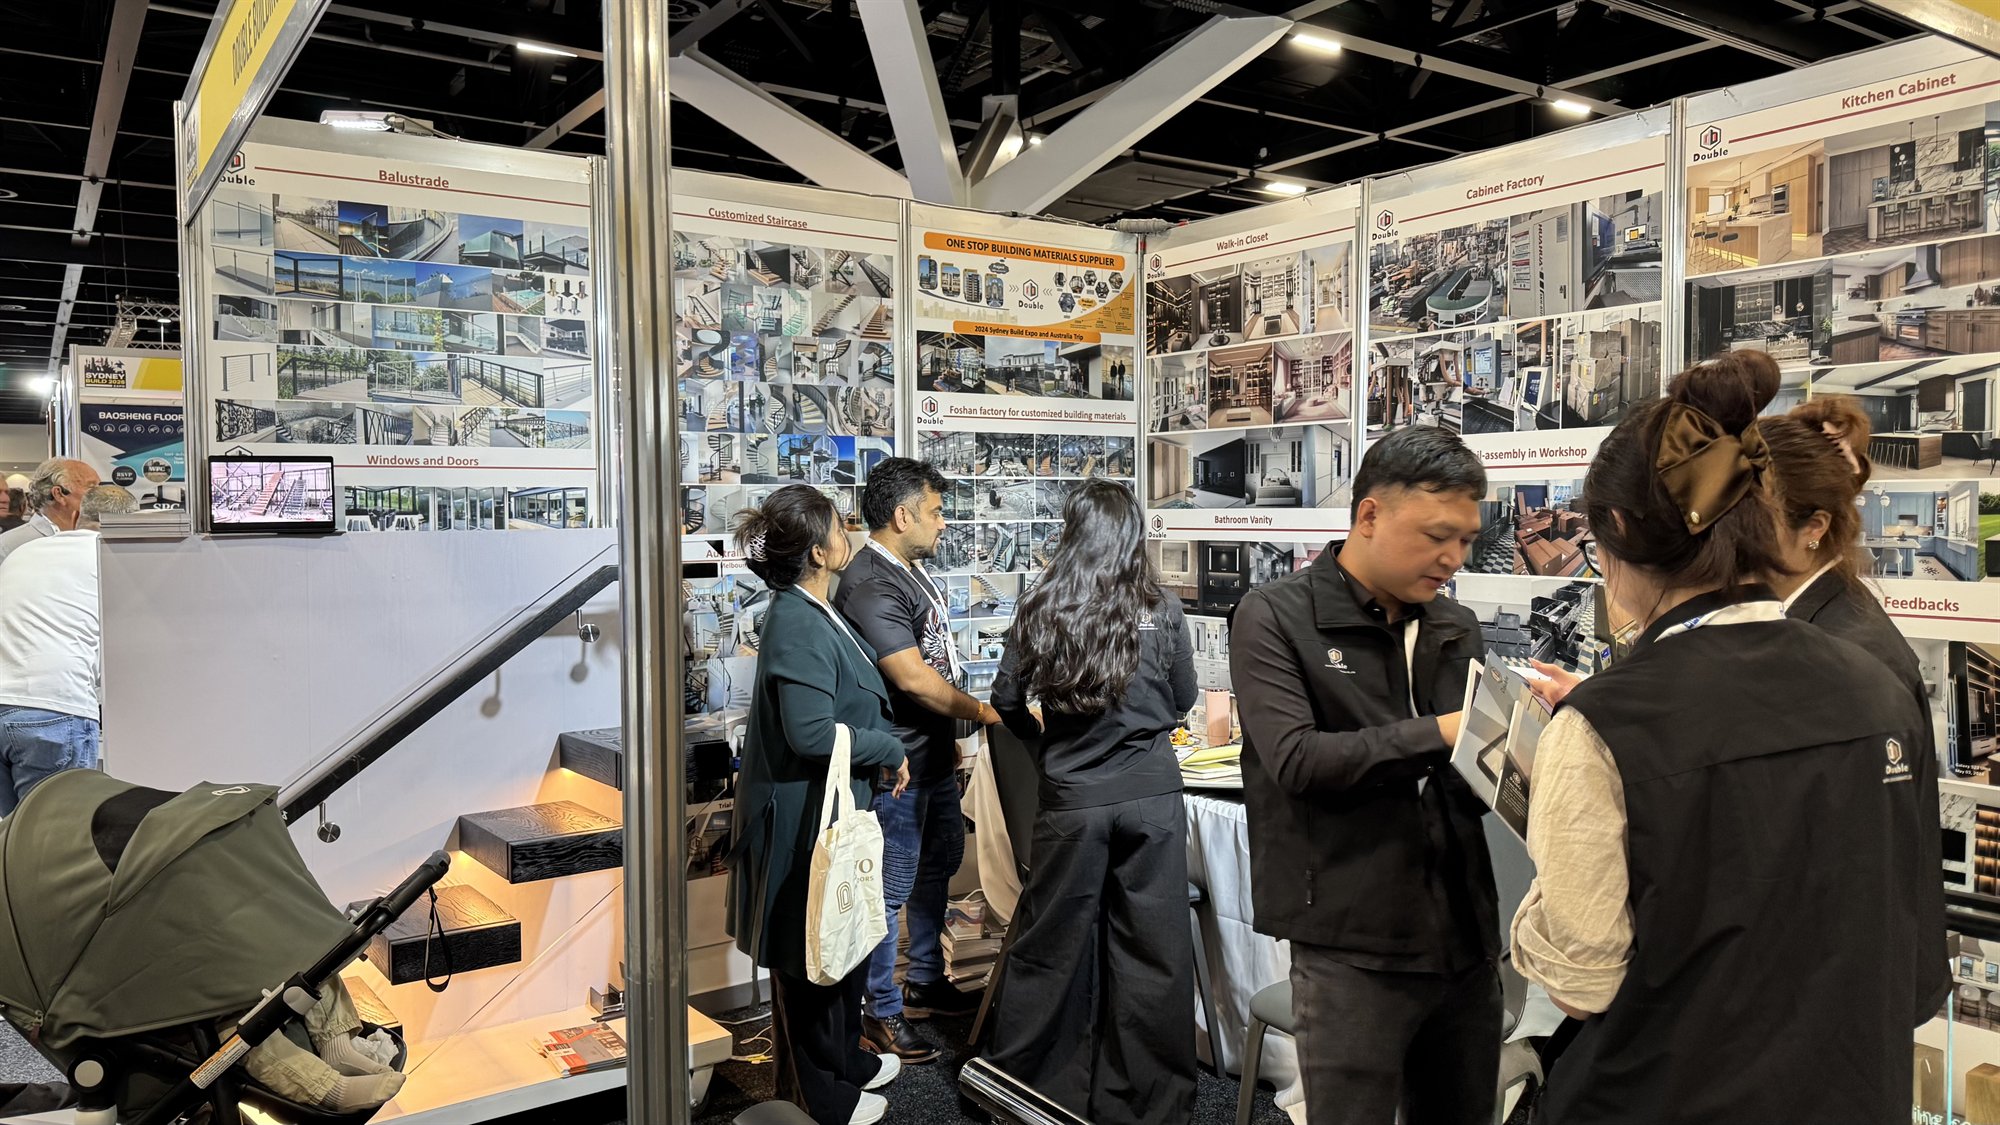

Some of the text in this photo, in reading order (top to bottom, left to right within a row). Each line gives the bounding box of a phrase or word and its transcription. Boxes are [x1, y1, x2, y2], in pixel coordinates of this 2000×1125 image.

[1841, 73, 1957, 110] Kitchen Cabinet
[1693, 148, 1729, 162] Double
[219, 174, 256, 187] ouble
[378, 170, 450, 188] Balustrade
[1466, 175, 1545, 200] Cabinet Factory
[708, 207, 808, 229] Customized Staircase
[1216, 232, 1269, 251] Walk-in Closet
[1372, 229, 1399, 241] Double
[946, 238, 1115, 267] ONE STOP BUILDING MATERIALS SUPPLIER
[1147, 271, 1166, 280] Double
[1018, 300, 1044, 310] Double
[974, 325, 1084, 341] 2024 Sydney Build Expo and Australia Trip
[85, 372, 125, 380] SYDNEY
[98, 411, 152, 420] BAOSHENG
[949, 405, 1127, 421] Foshan factory for customized building materials
[917, 416, 944, 425] Double
[1528, 448, 1537, 458] in
[1539, 447, 1587, 459] Workshop
[366, 454, 480, 467] Windows and Doors
[1214, 515, 1273, 526] Bathroom Vanity
[1148, 531, 1167, 539] Double
[1883, 596, 1960, 612] Feedbacks
